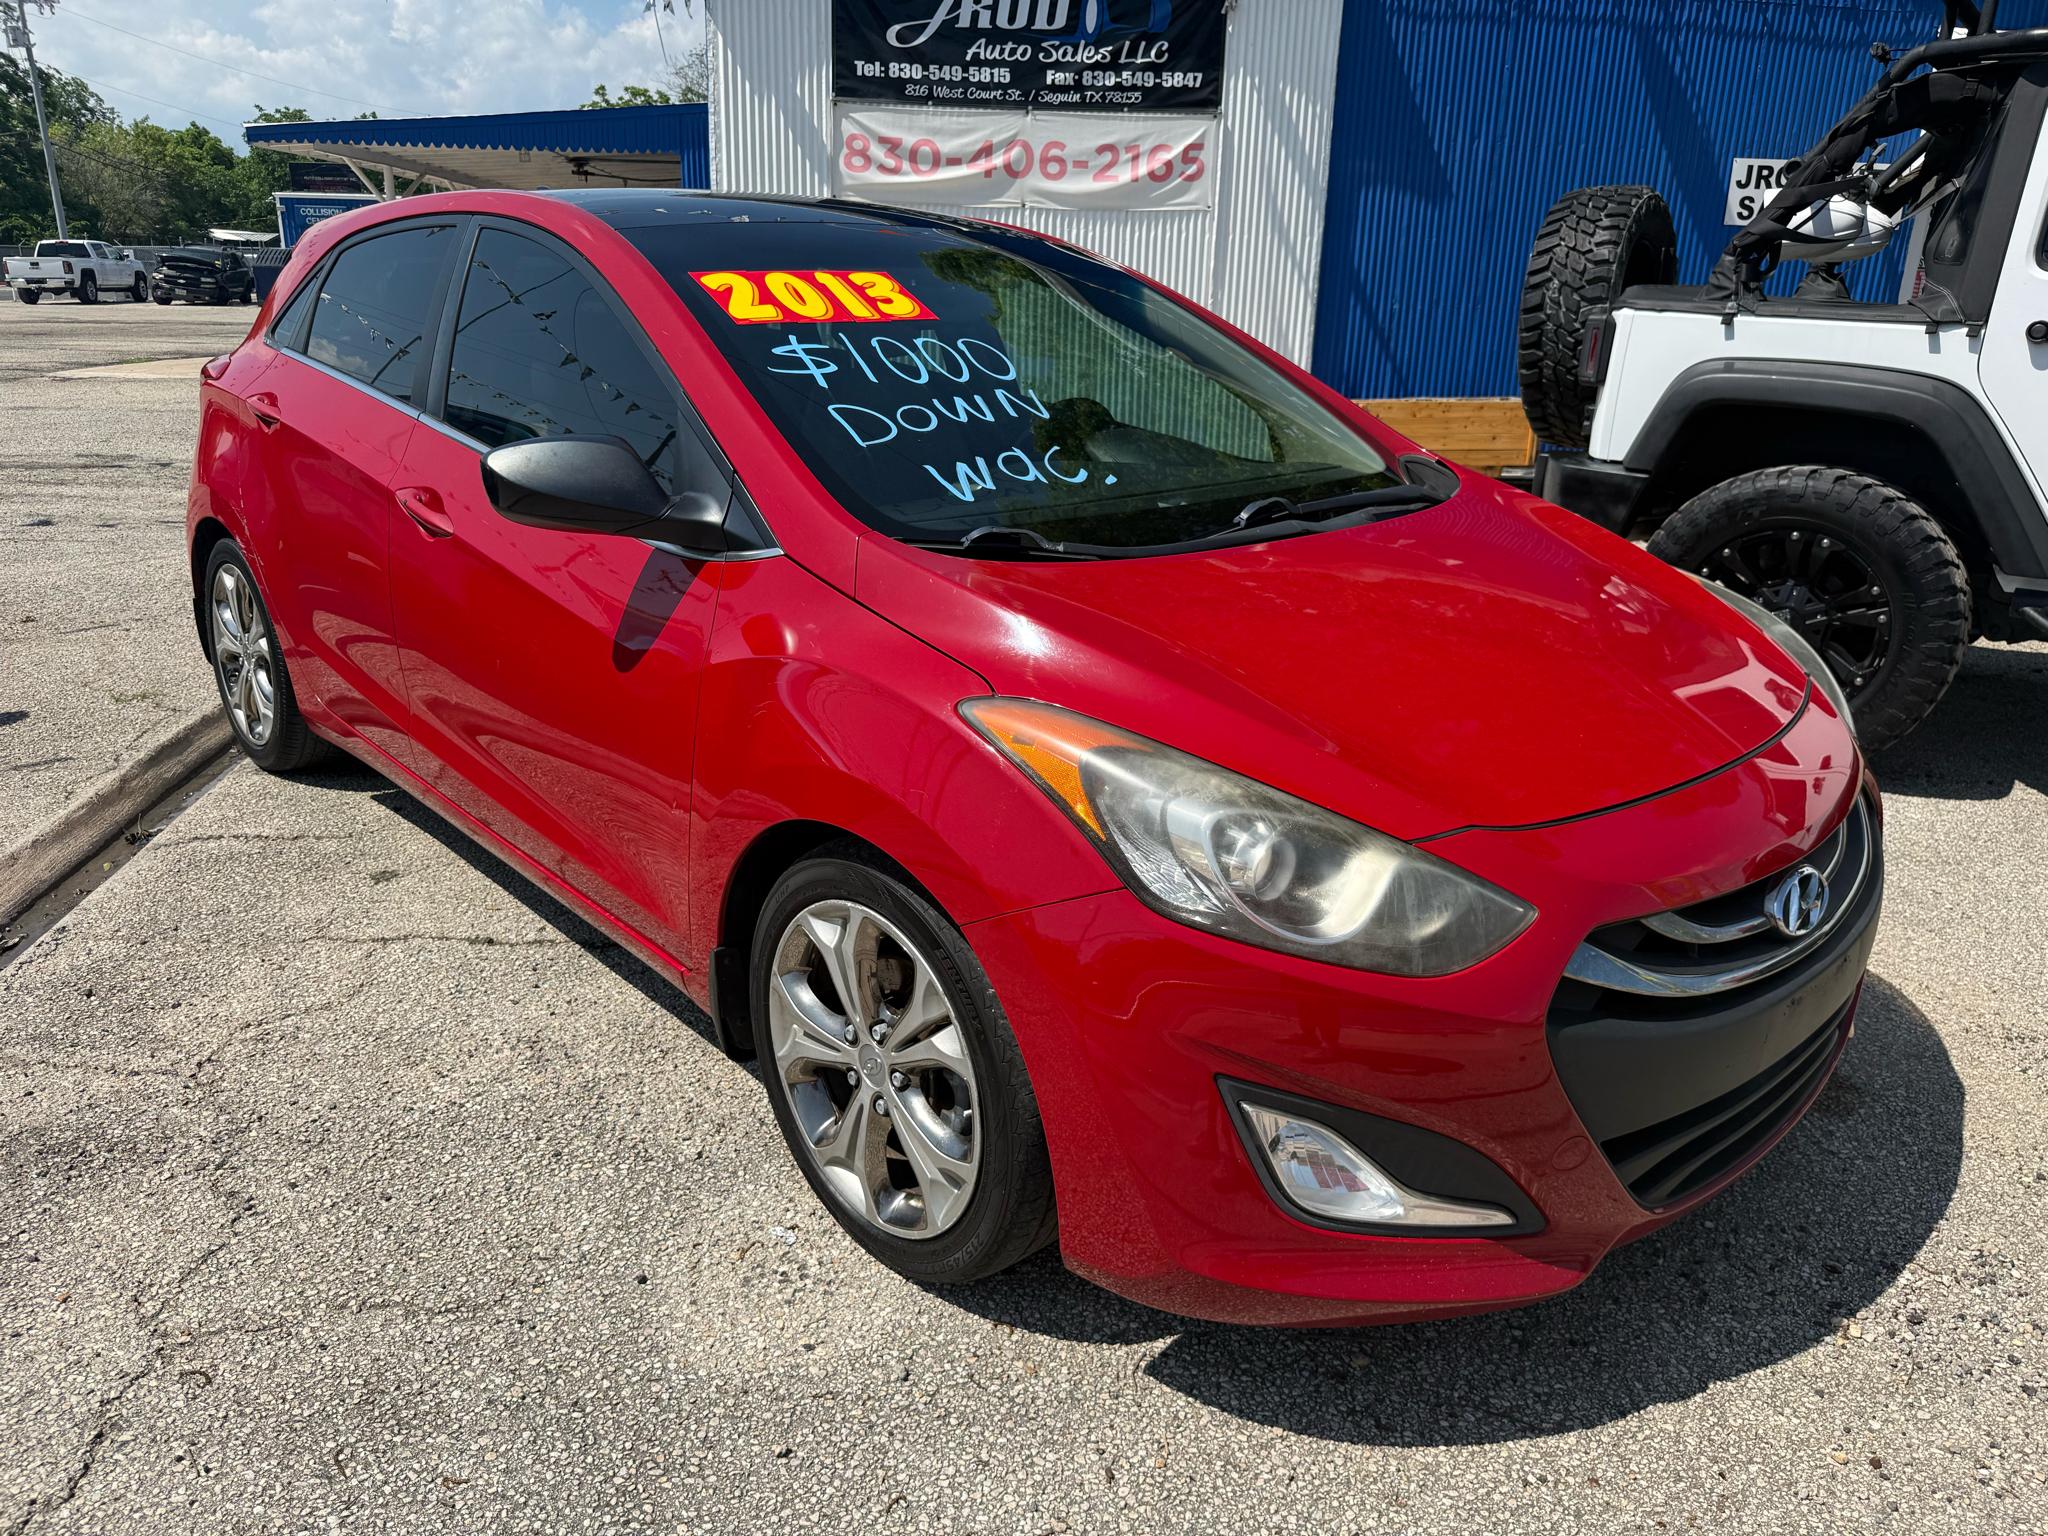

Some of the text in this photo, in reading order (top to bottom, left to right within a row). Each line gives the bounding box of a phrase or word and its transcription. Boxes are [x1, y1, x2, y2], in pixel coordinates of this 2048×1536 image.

[965, 38, 1169, 64] Auto Sales LLC
[854, 60, 1011, 84] Tel: 830-549-5815
[1082, 70, 1203, 88] 830-549-5847
[905, 83, 929, 97] 816
[933, 85, 965, 99] West
[967, 87, 1003, 100] Court
[1006, 89, 1025, 101] St.
[1038, 91, 1081, 105] Seguin
[1084, 91, 1103, 102] TX
[1105, 91, 1143, 104] 78155
[842, 132, 1206, 184] 830-406-2165
[700, 272, 922, 322] 2013
[767, 332, 1016, 389] $1000
